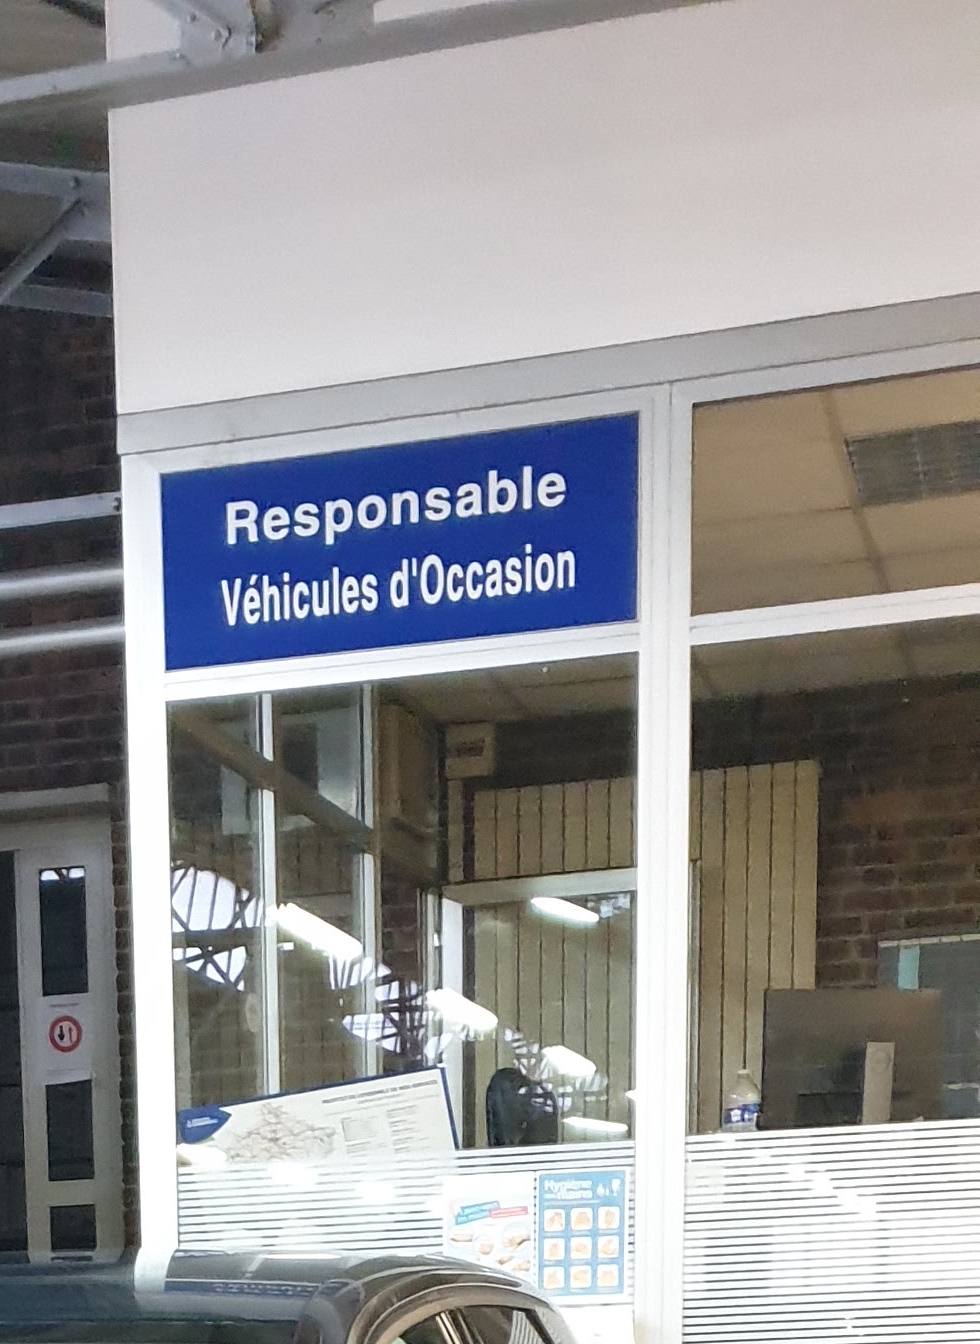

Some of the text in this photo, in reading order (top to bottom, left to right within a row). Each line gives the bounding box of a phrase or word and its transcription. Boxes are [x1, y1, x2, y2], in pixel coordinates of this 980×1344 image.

[225, 465, 567, 545] Responsable
[221, 543, 577, 626] Véhicules d'Occasion
